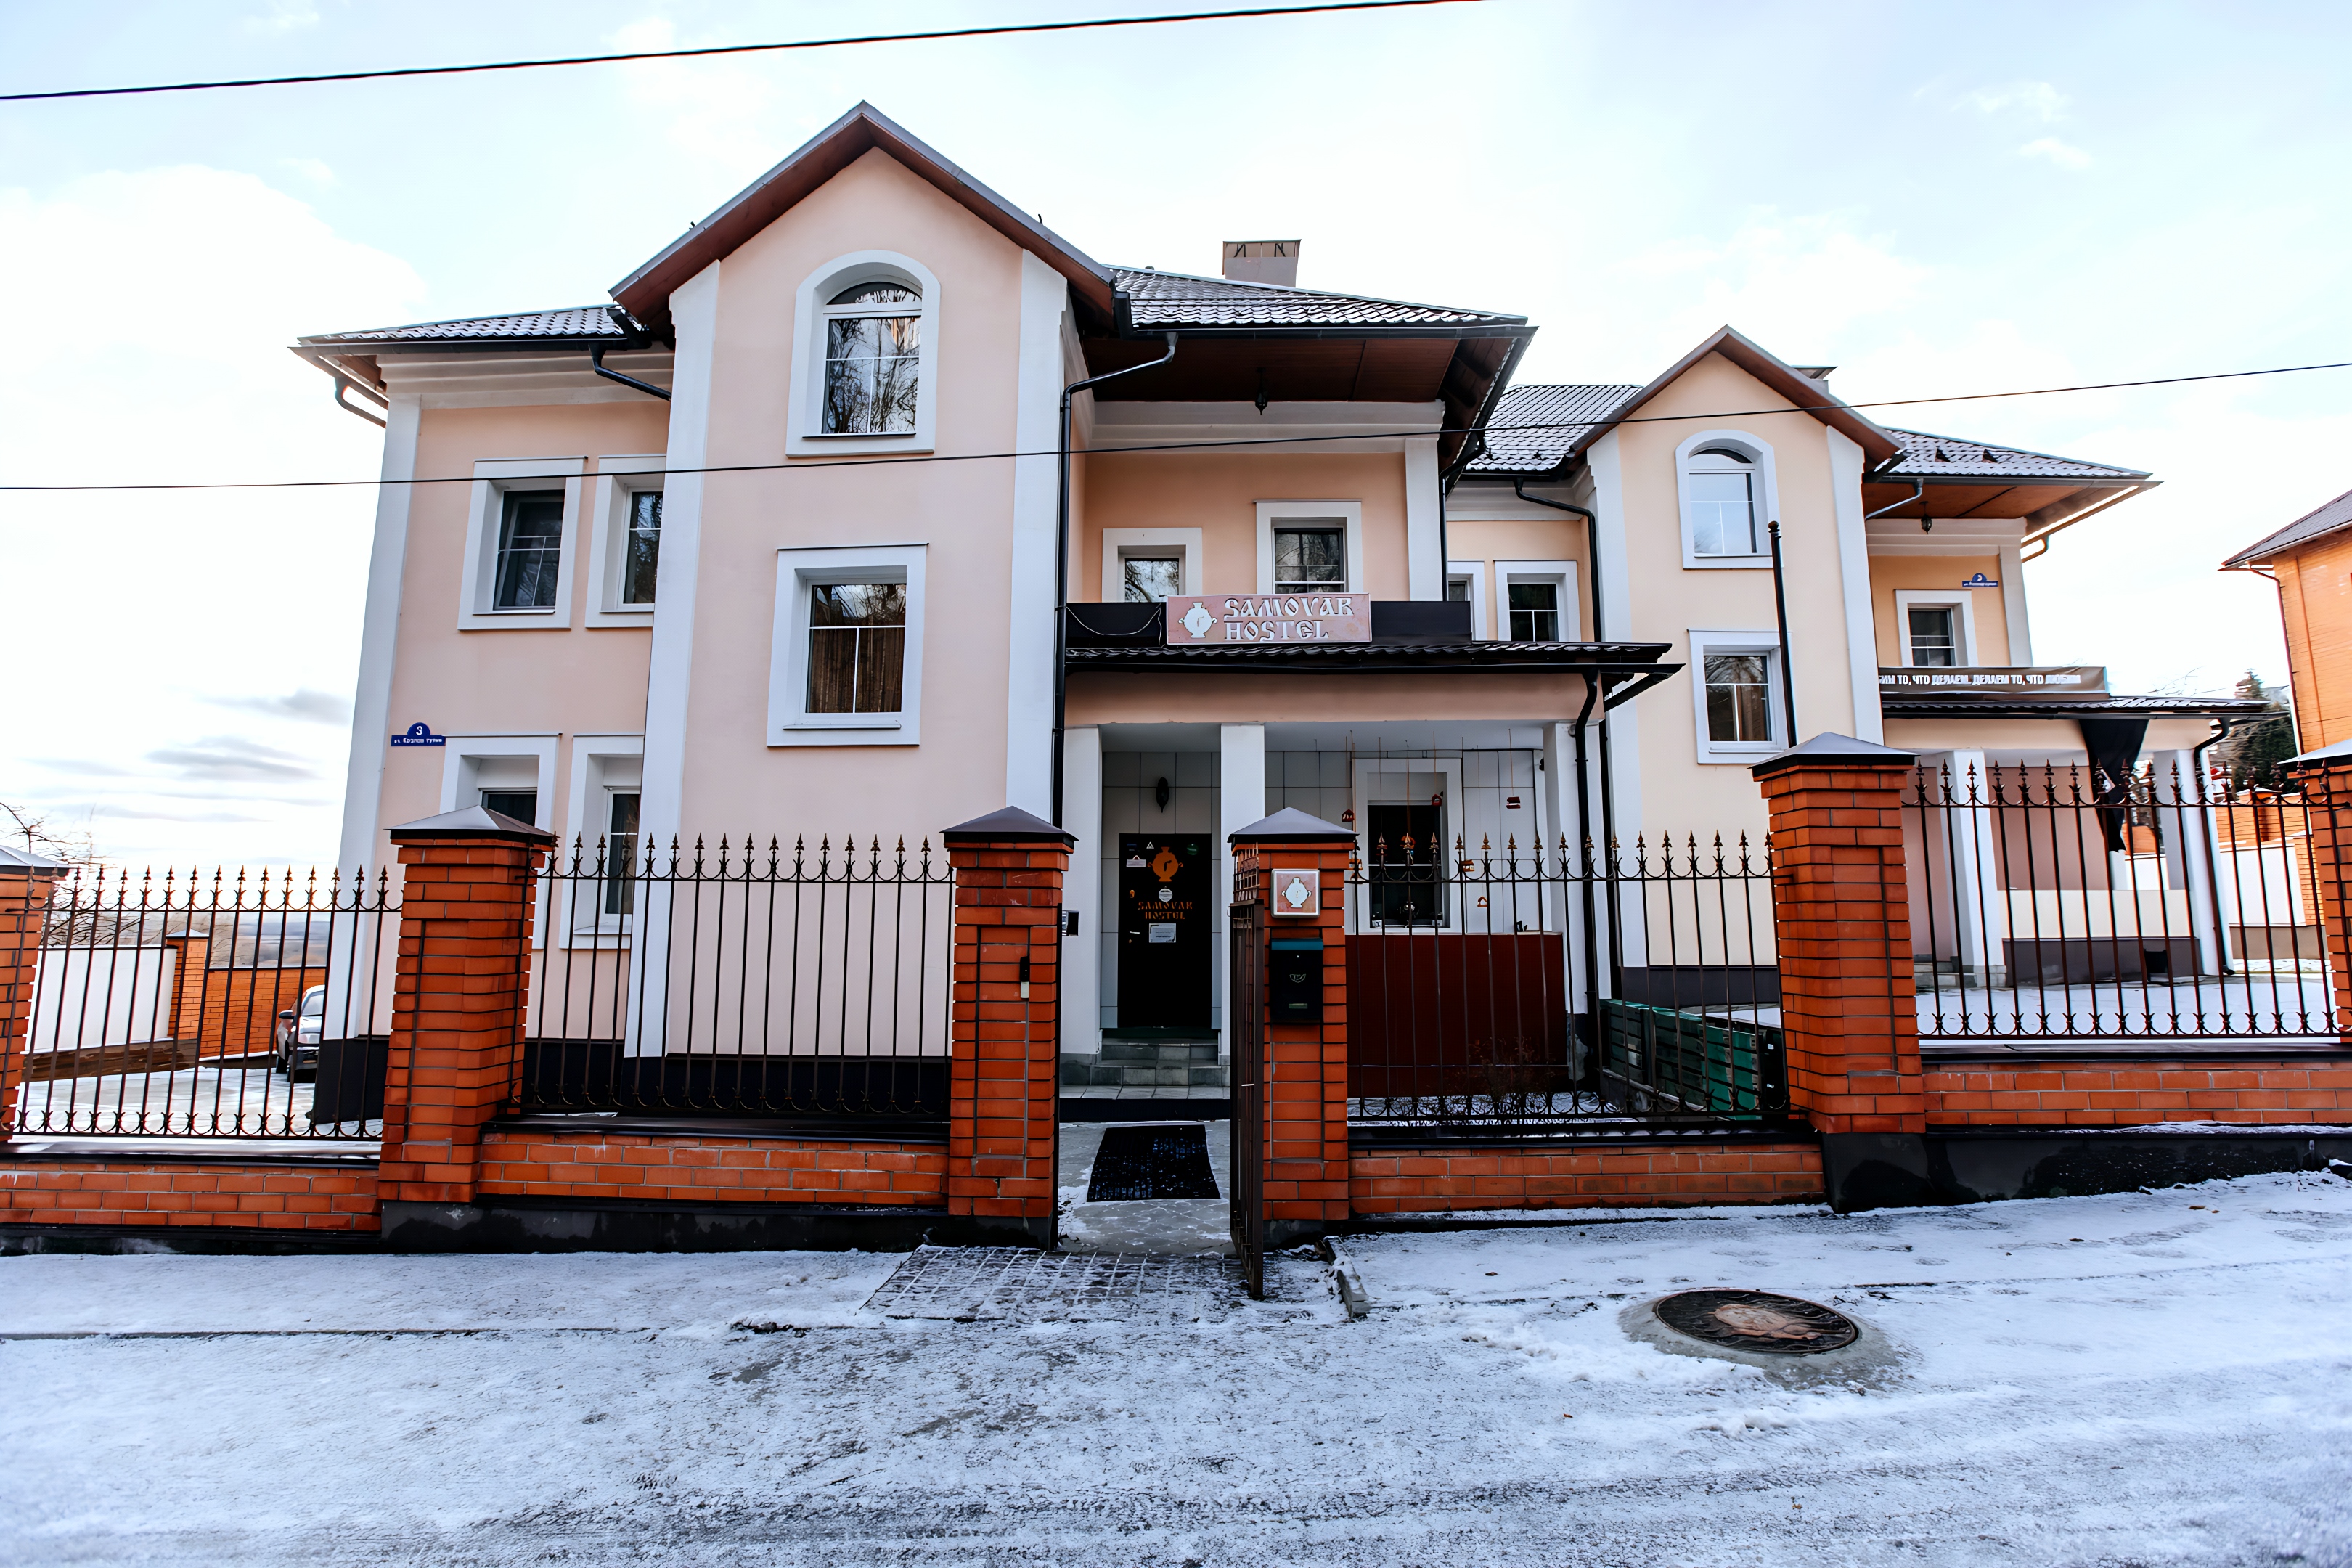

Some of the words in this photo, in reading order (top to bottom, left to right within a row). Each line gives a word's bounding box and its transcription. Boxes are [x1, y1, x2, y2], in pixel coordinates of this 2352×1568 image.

[1224, 597, 1355, 619] SAMOVAR
[1224, 619, 1329, 642] HOSTEL
[1897, 675, 1911, 686] ТО,
[1912, 675, 1930, 685] ЧТО
[2010, 675, 2025, 685] ТО,
[2025, 675, 2044, 685] ЧТО
[416, 726, 423, 735] 3
